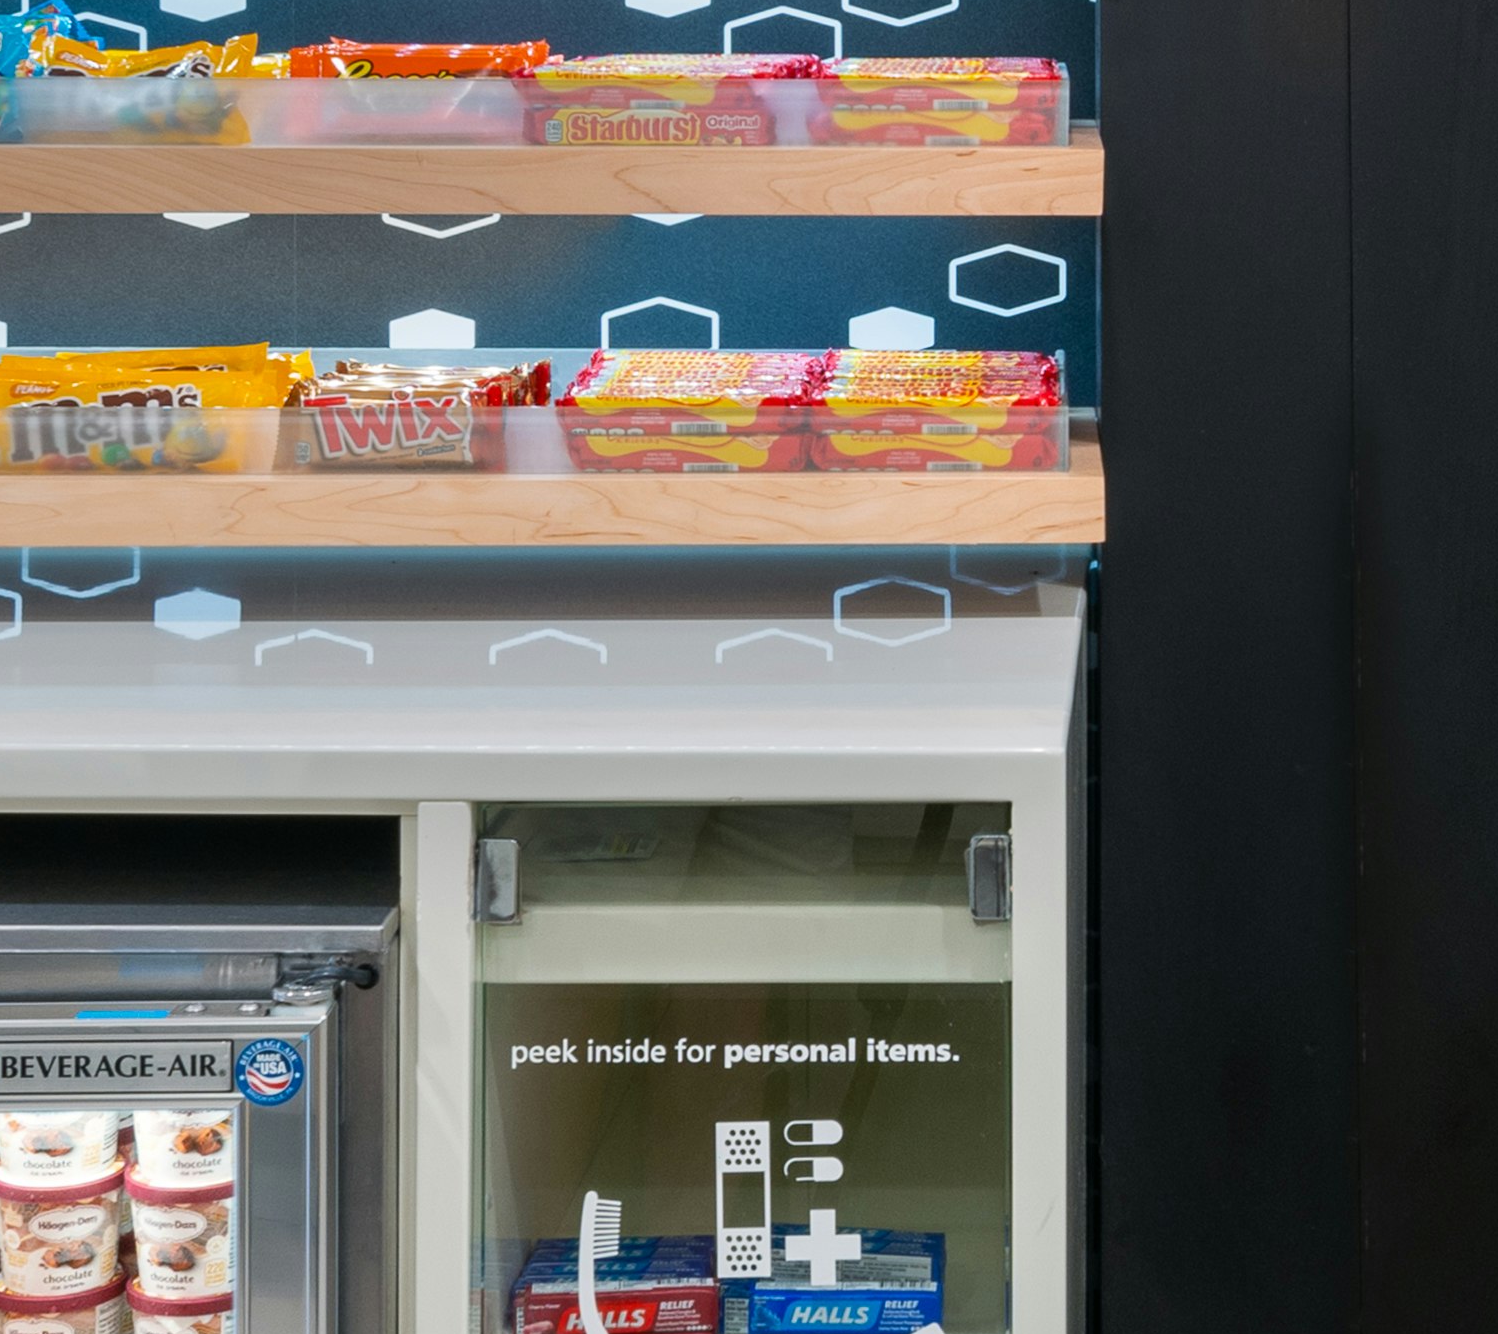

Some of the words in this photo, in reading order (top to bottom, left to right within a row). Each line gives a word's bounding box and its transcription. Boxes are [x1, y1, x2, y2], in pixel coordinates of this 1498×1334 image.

[566, 112, 700, 143] Starburst
[257, 1054, 281, 1063] MADE
[511, 1040, 577, 1069] peek
[587, 1039, 666, 1063] inside
[674, 1038, 715, 1063] for
[724, 1038, 856, 1068] personal
[866, 1038, 960, 1063] items.
[0, 1054, 216, 1080] BEVERAGE-AIR
[260, 1061, 287, 1075] USA
[566, 1309, 645, 1331] HLLS
[660, 1300, 695, 1310] RELIEF
[791, 1307, 869, 1324] HALLS
[885, 1301, 919, 1309] RELIEF
